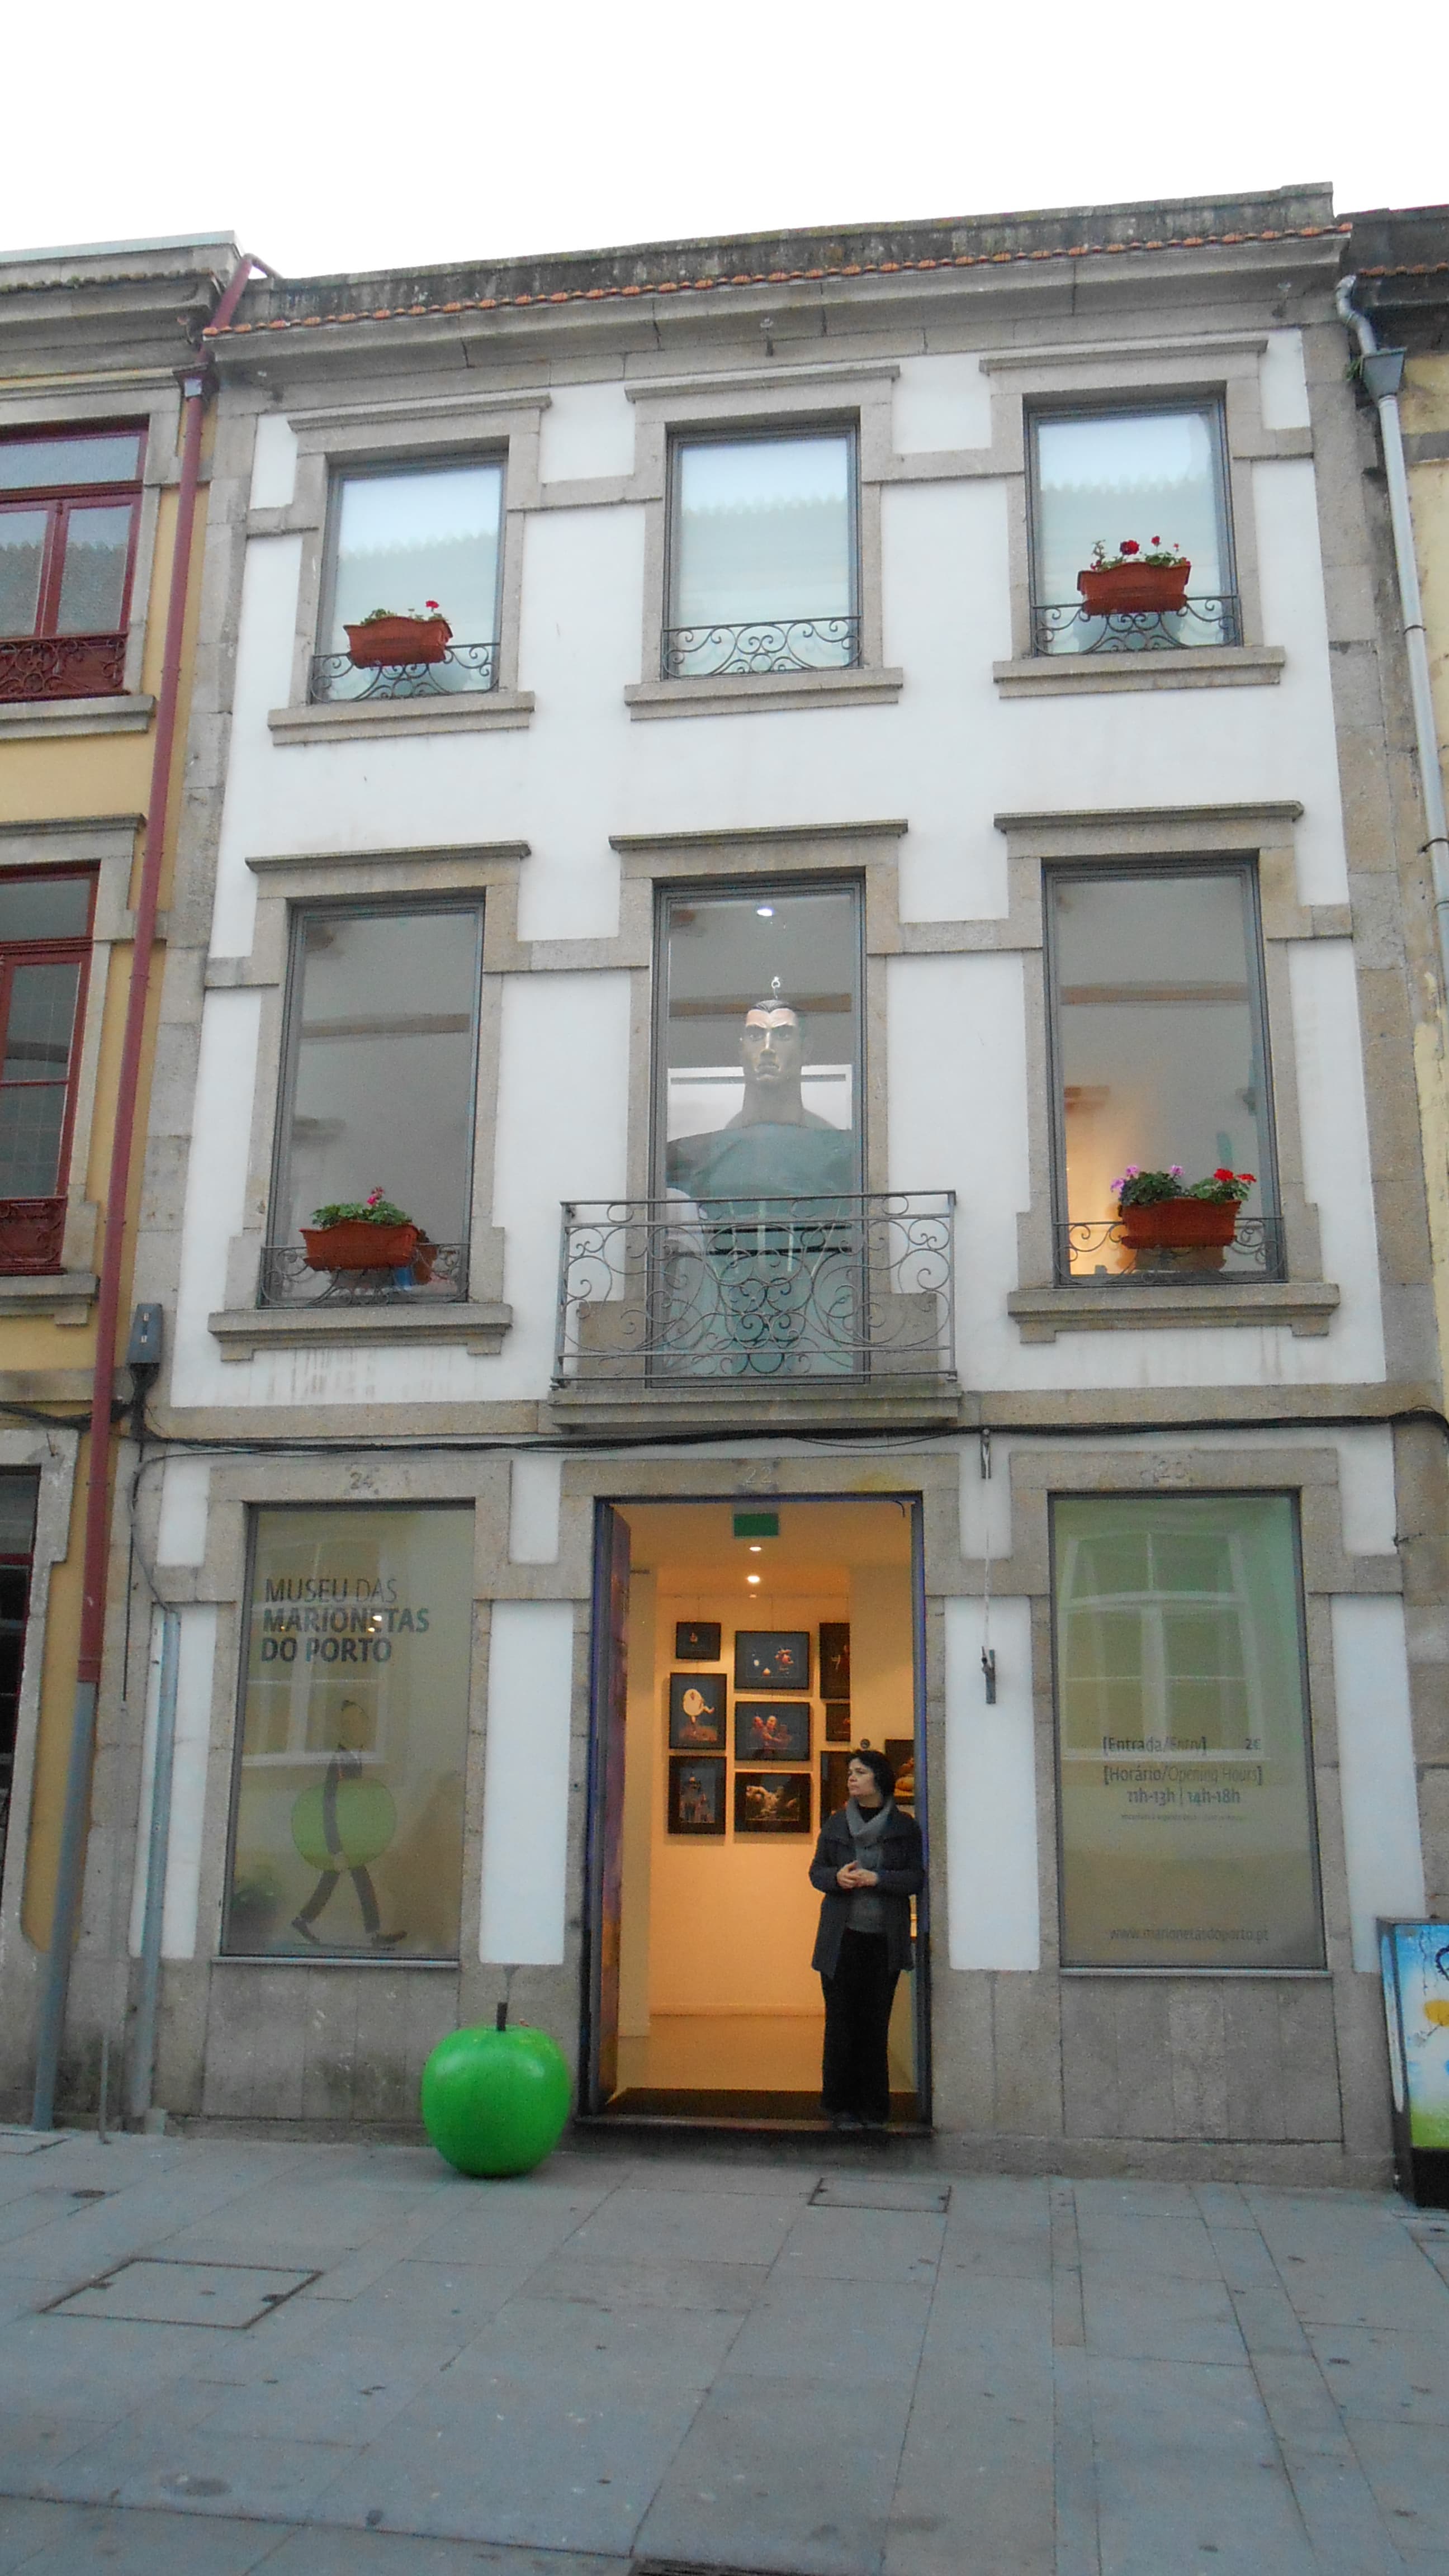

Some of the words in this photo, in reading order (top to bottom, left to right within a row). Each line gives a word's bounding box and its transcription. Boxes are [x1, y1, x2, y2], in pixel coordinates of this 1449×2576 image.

[746, 1466, 772, 1484] 22
[265, 1578, 348, 1603] MUSEU
[356, 1578, 397, 1603] DAS
[262, 1607, 430, 1633] MARIONETAS
[261, 1637, 297, 1663] DO
[305, 1637, 392, 1663] PORTO
[1187, 1787, 1240, 1806] 14h-18h
